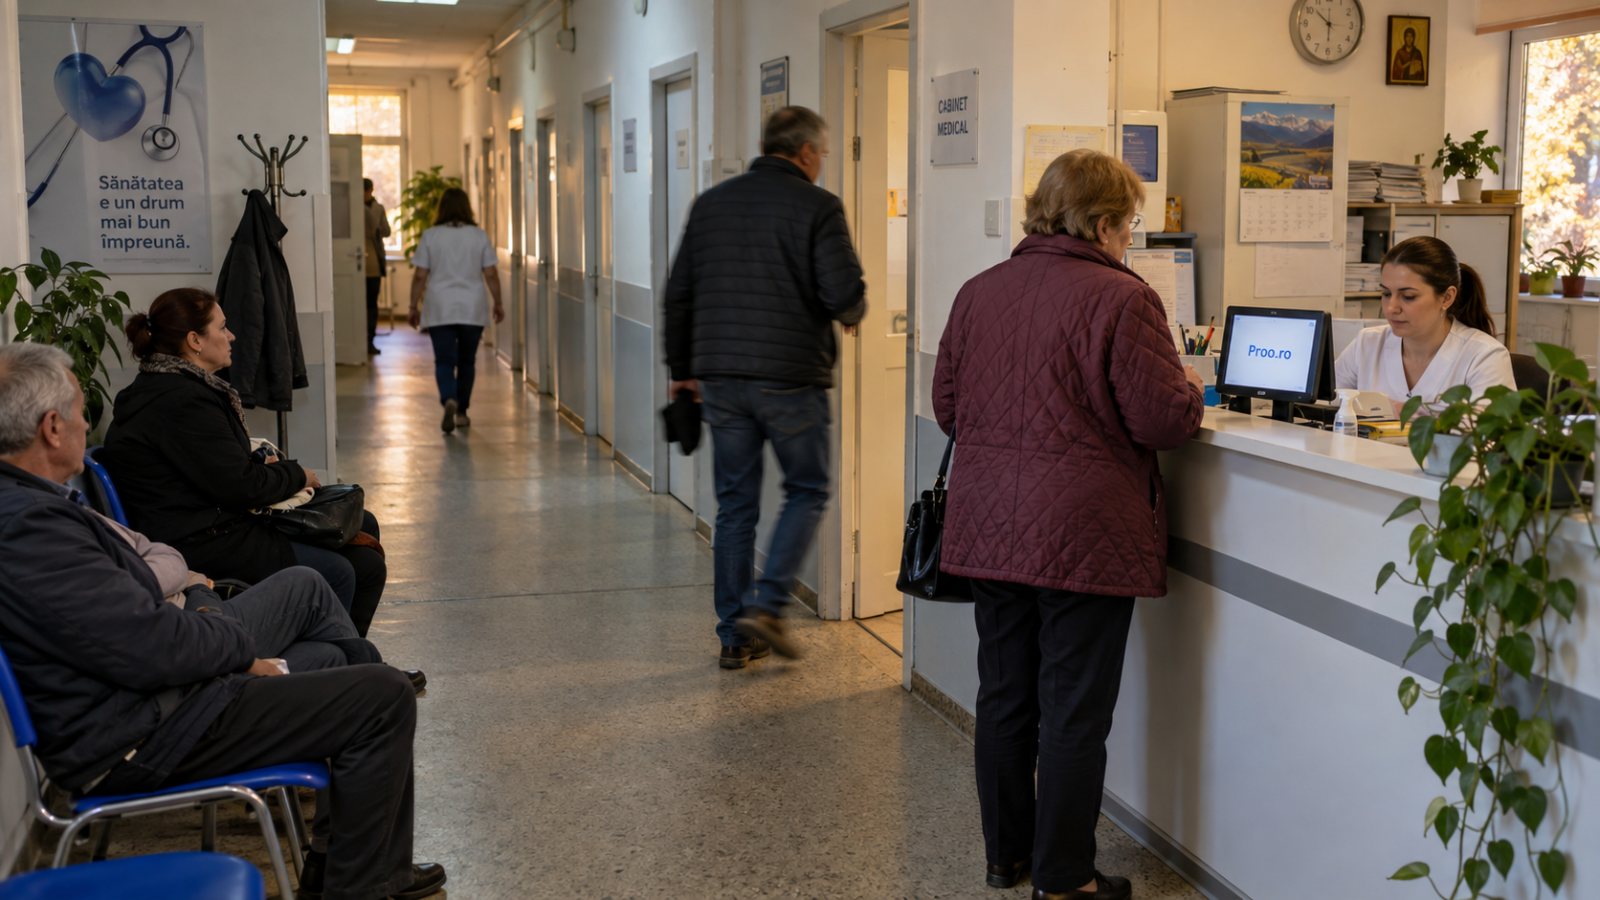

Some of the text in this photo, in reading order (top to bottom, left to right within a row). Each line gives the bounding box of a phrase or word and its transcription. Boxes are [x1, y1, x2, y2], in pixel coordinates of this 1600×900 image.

[1306, 6, 1314, 14] 10
[1346, 8, 1351, 16] 2
[1349, 21, 1353, 30] 3
[1314, 43, 1320, 52] 7
[1325, 47, 1330, 55] 6
[1337, 43, 1342, 53] 5
[938, 96, 968, 114] CABINET
[937, 120, 968, 136] MEDICAL
[99, 175, 184, 190] Sănătatea
[99, 195, 184, 209] e un drum
[101, 215, 170, 229] mai bun
[101, 234, 190, 252] împreună.
[1248, 345, 1292, 360] Proo.ro
